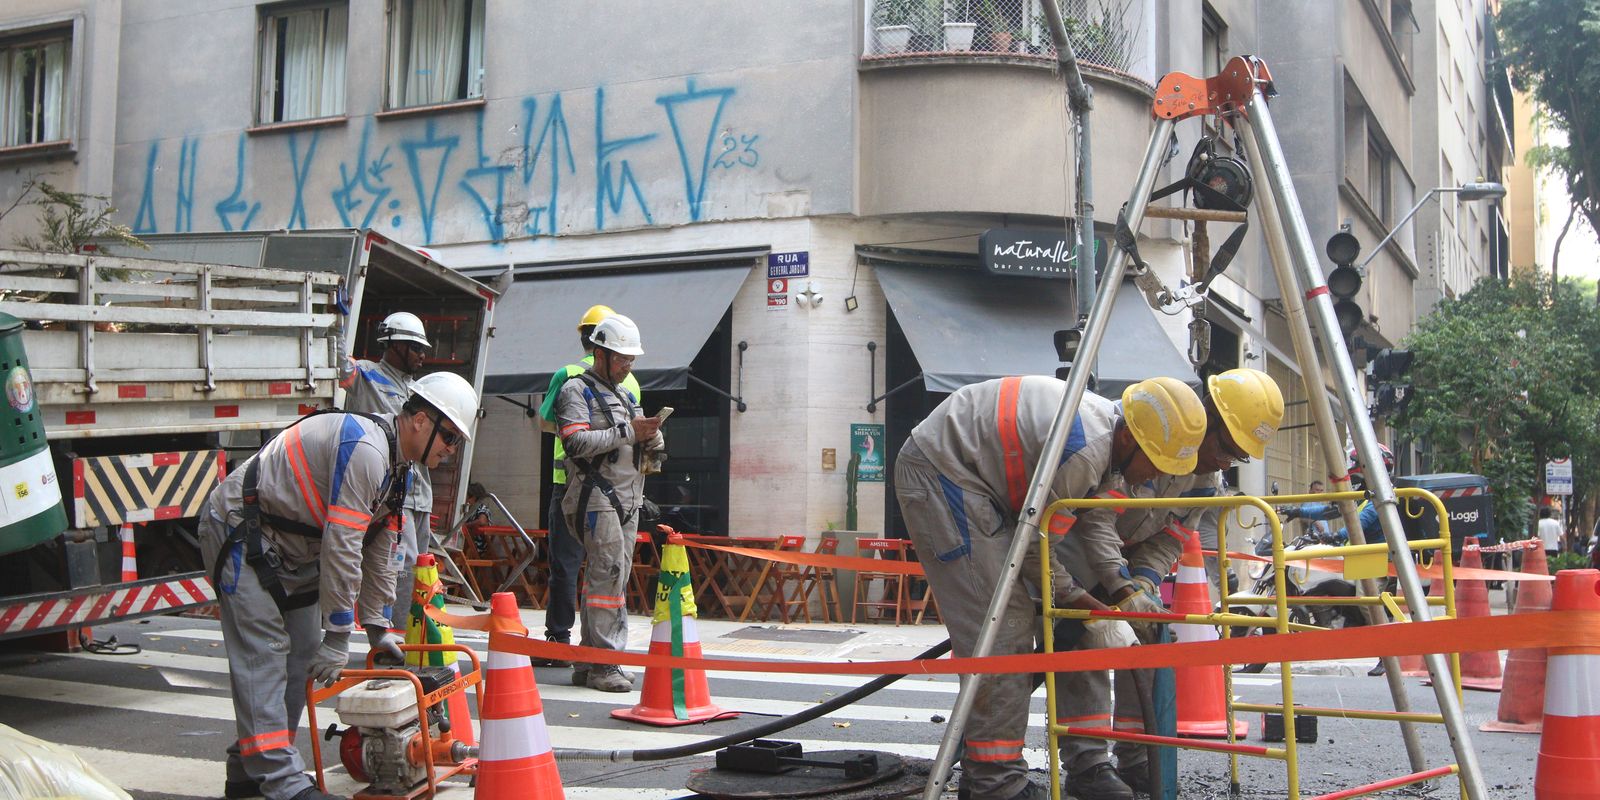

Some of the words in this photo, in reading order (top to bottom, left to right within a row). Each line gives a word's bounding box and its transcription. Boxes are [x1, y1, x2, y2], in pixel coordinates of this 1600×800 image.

[777, 253, 799, 264] RUA
[994, 240, 1077, 263] naturalle
[1451, 509, 1479, 523] Loggi
